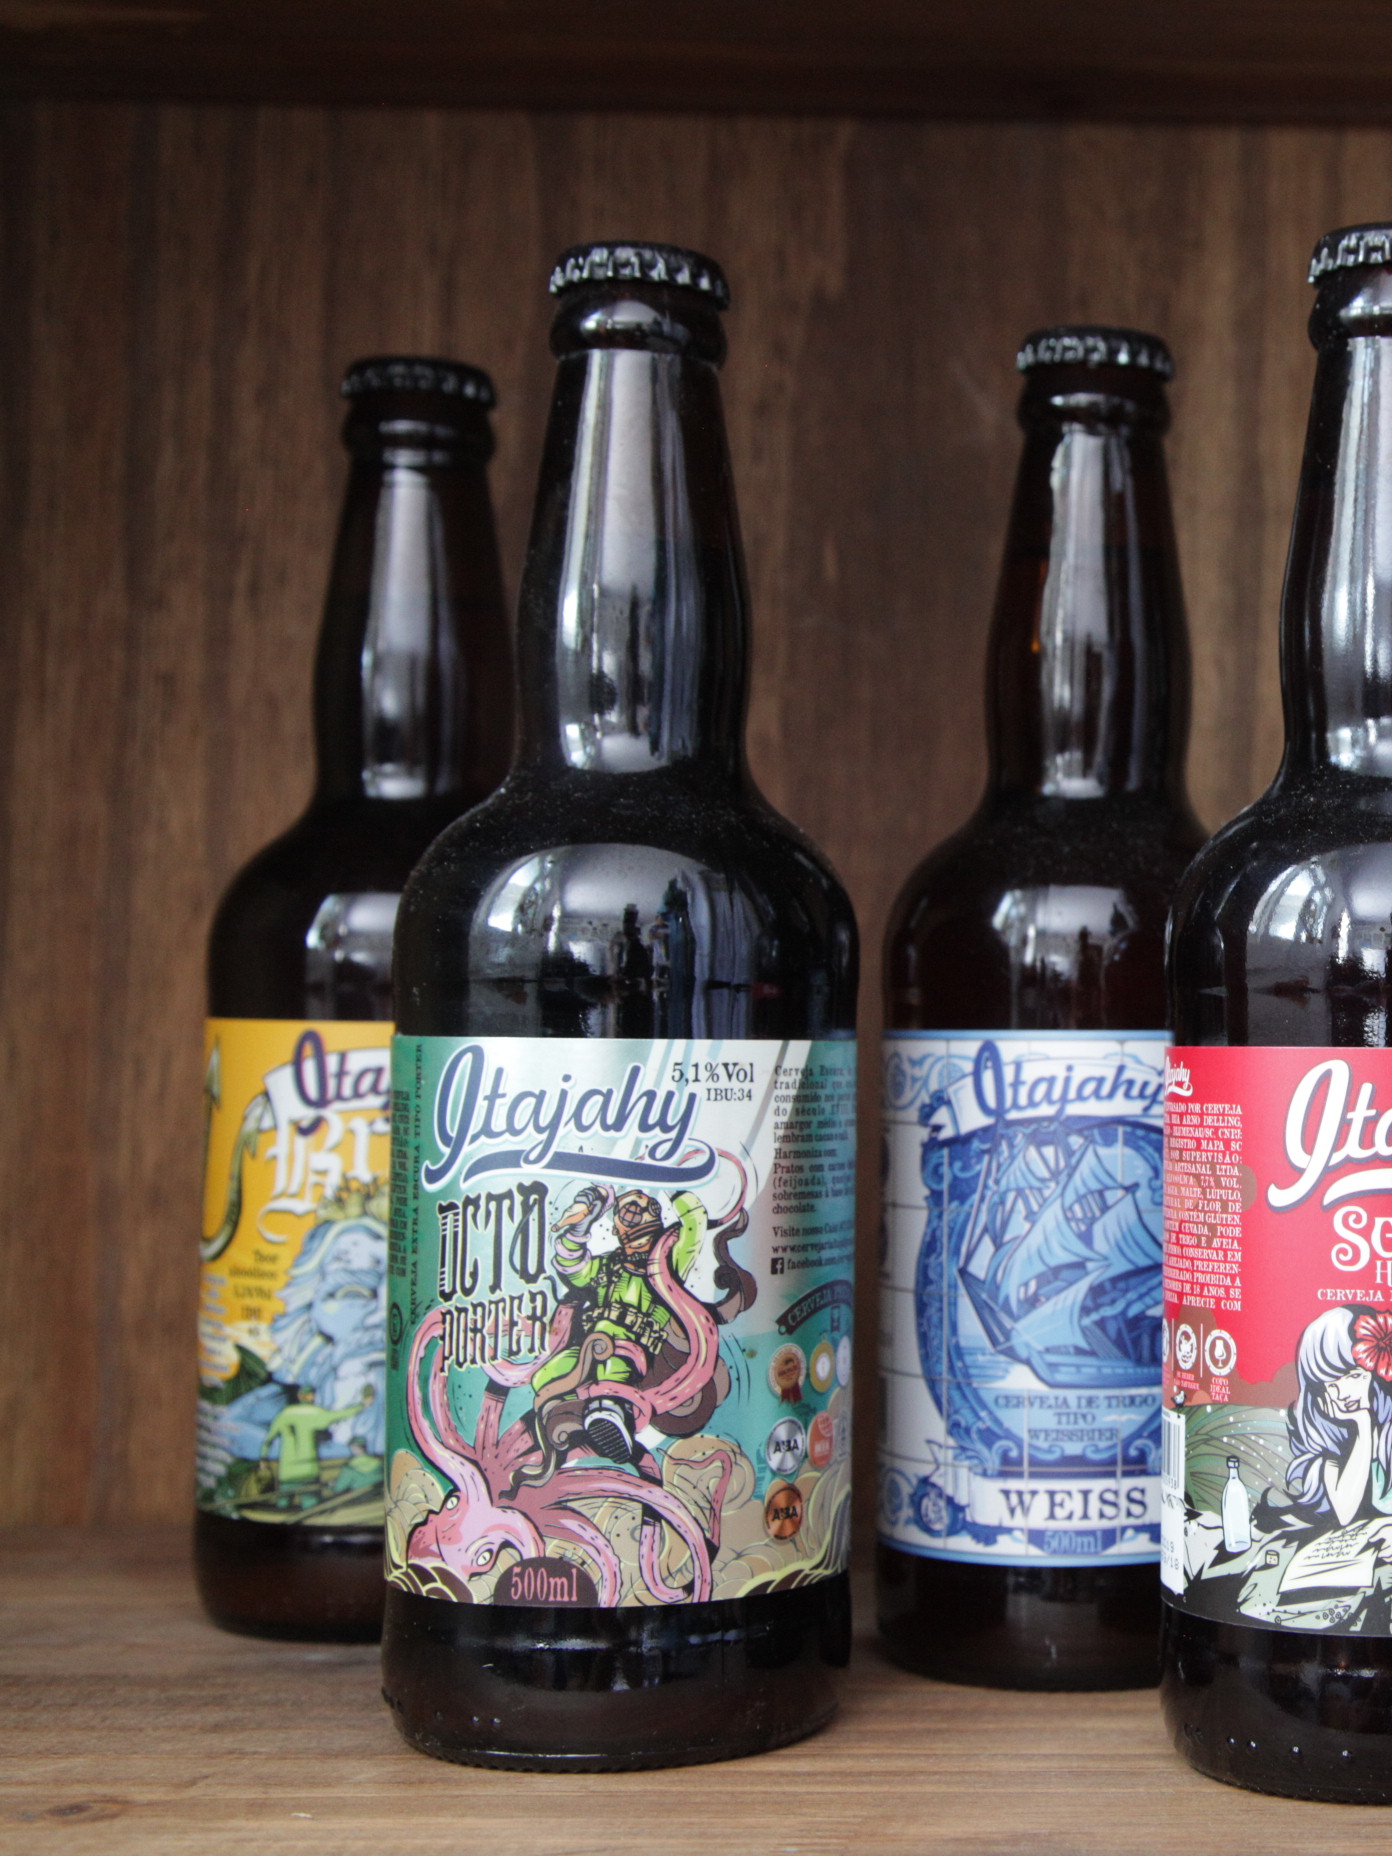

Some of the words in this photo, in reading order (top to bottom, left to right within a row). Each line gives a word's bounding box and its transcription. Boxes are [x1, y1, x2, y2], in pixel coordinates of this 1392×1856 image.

[973, 1040, 1163, 1125] Itajahy
[706, 1088, 752, 1101] IBU:34
[422, 1043, 716, 1186] Itajahy
[774, 1105, 787, 1116] do
[1203, 1103, 1243, 1115] CERVEJA
[1200, 1139, 1225, 1151] MAPA
[1230, 1141, 1243, 1152] SC
[1184, 1199, 1195, 1209] DE
[1198, 1199, 1222, 1212] FLOR
[1228, 1202, 1243, 1213] DE
[772, 1225, 800, 1238] Visite
[1216, 1225, 1243, 1237] PODE
[437, 1180, 549, 1302] OCTO
[1201, 1237, 1207, 1247] E
[1182, 1247, 1225, 1261] CONSERVAR
[1227, 1251, 1243, 1262] EM
[1193, 1271, 1233, 1286] PROIBIDA
[1234, 1275, 1243, 1287] A
[1183, 1282, 1193, 1294] DE
[1229, 1288, 1243, 1300] SE
[1316, 1288, 1385, 1302] CERVEJA
[1182, 1295, 1216, 1309] APRECIE
[1221, 1299, 1243, 1311] COM
[440, 1290, 551, 1376] PORTER
[994, 1394, 1071, 1409] CERVEJA
[1077, 1394, 1100, 1409] DE
[1053, 1412, 1096, 1426] TIPO
[999, 1487, 1148, 1521] WEISS
[510, 1565, 578, 1602] 500ml
